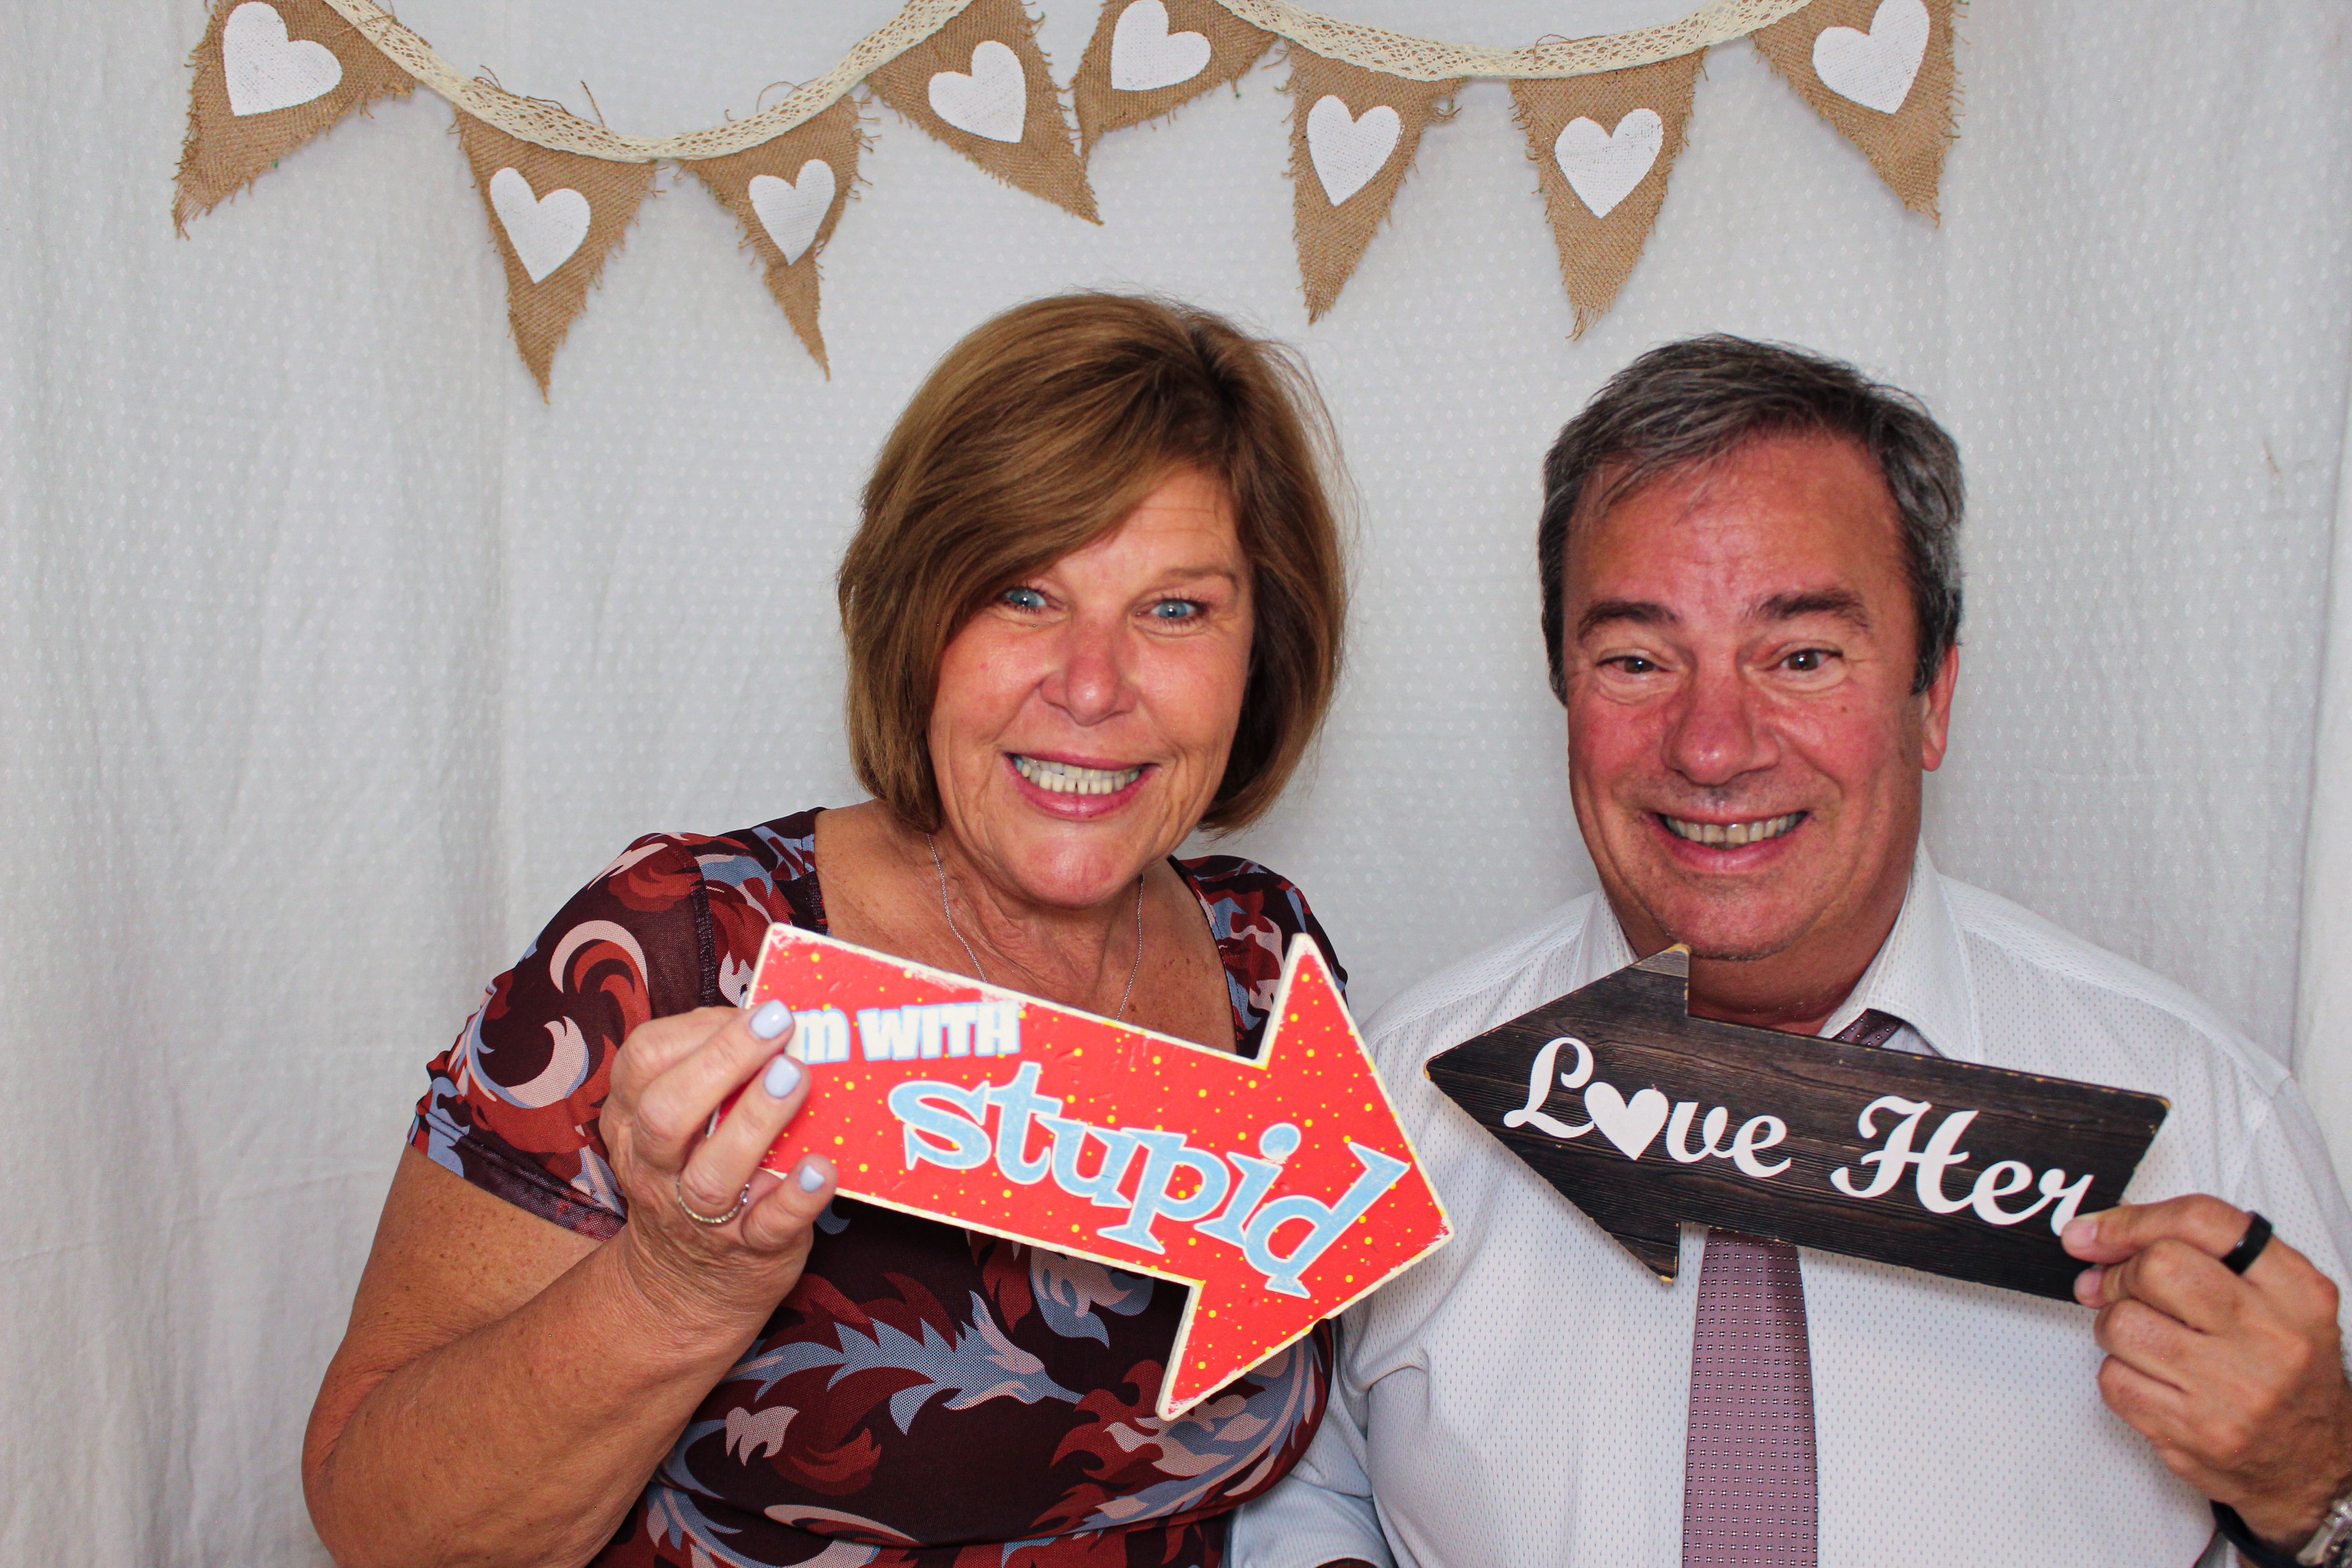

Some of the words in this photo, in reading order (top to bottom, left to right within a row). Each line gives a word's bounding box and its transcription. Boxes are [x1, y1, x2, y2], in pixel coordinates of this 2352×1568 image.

[856, 1000, 1020, 1062] WITH
[887, 1060, 1411, 1299] stupid
[1830, 1095, 2094, 1236] Her
